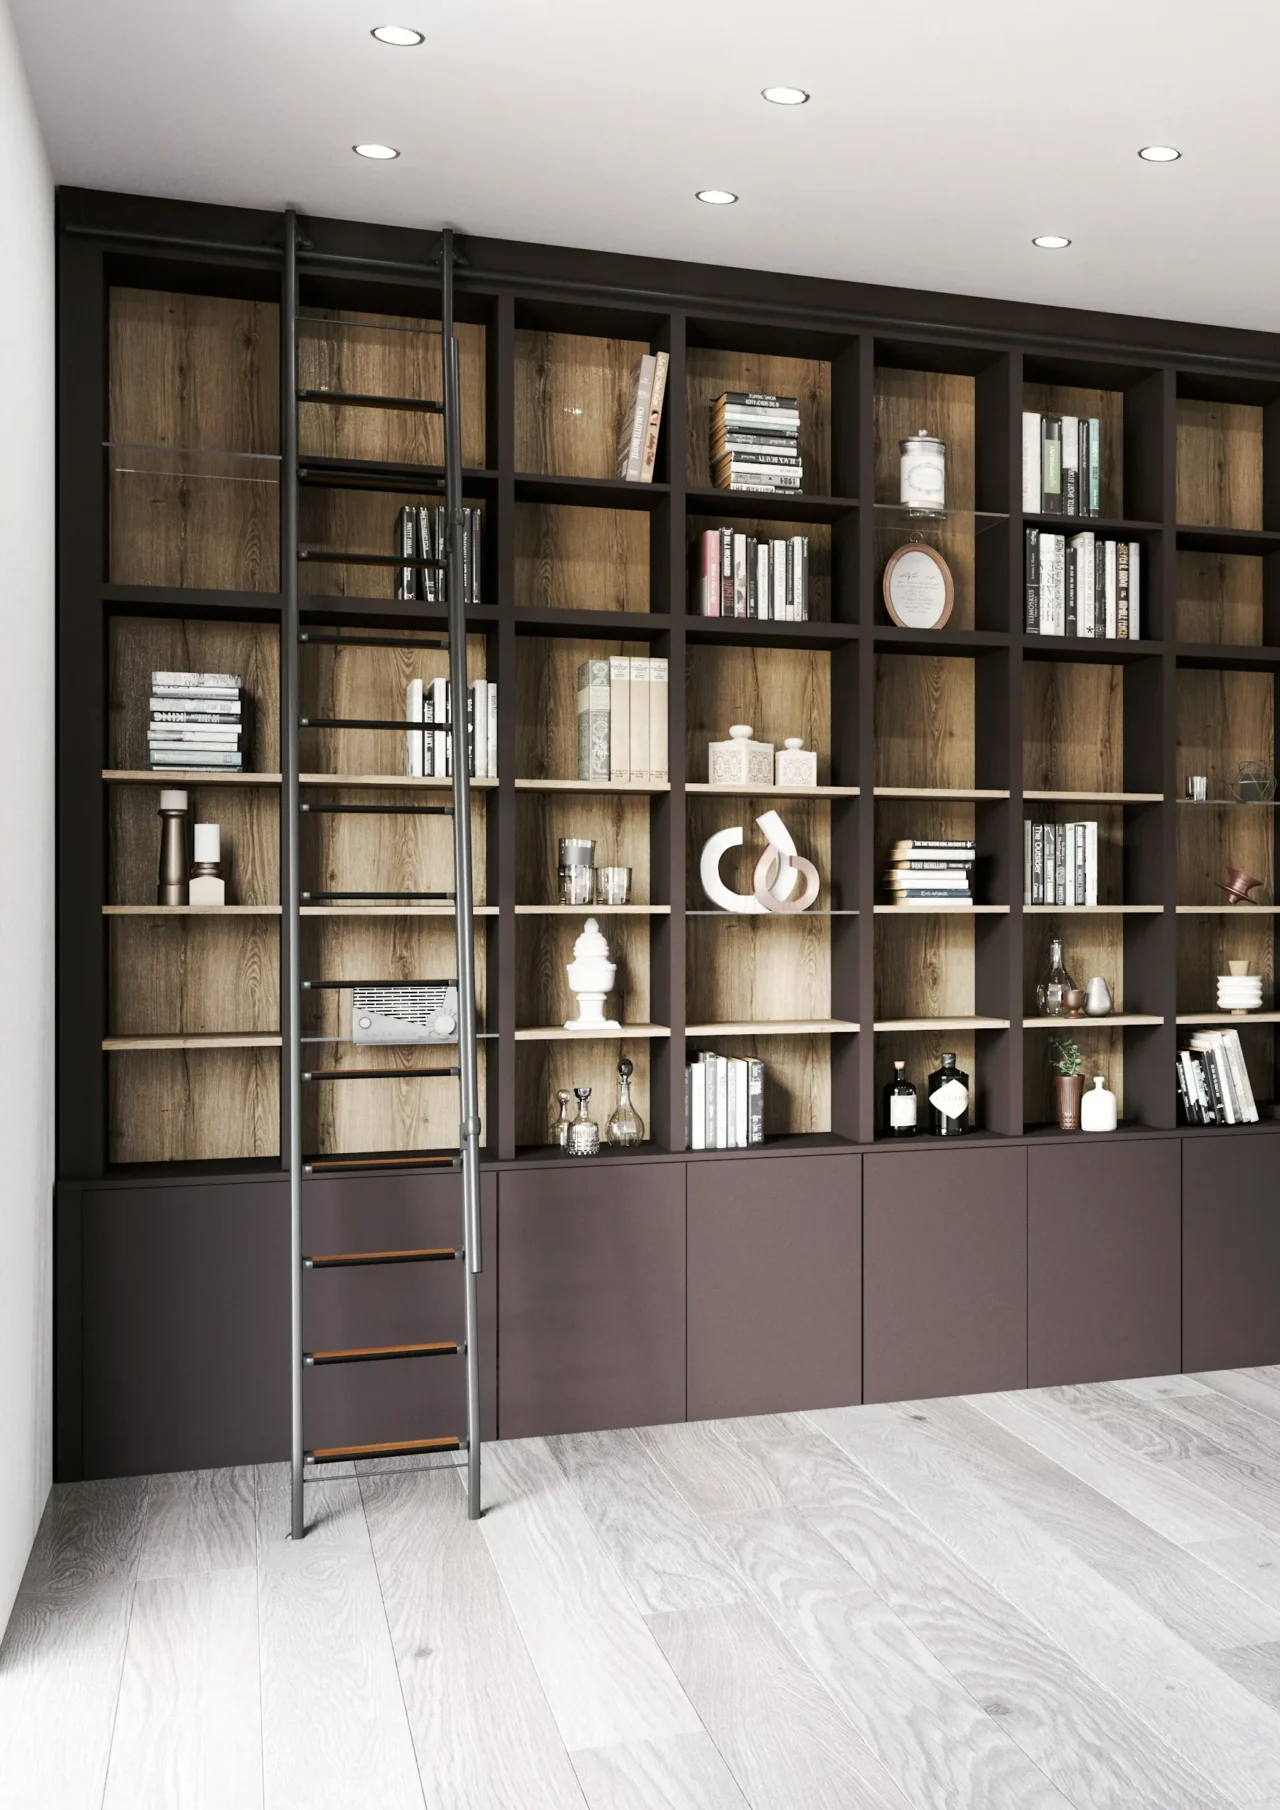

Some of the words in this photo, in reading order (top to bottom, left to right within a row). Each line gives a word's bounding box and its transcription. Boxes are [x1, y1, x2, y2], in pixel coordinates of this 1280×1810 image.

[758, 455, 778, 463] BEAUTY
[779, 457, 796, 465] BLACK
[153, 712, 184, 721] KING
